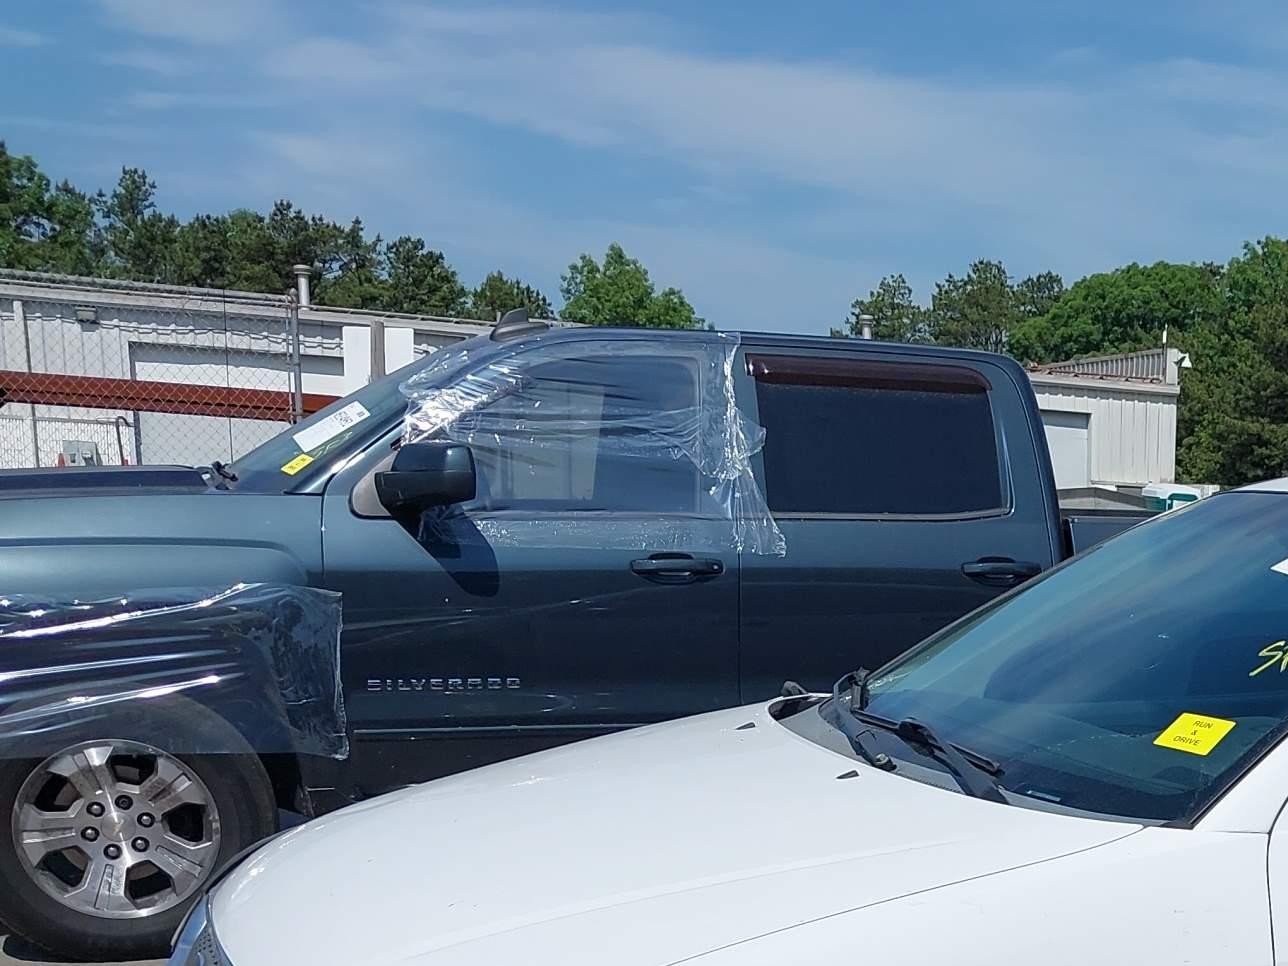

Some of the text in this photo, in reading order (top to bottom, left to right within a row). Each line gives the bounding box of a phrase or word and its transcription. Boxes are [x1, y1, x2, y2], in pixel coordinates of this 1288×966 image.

[367, 677, 521, 691] SILVERADO
[1192, 720, 1213, 729] RUN
[1173, 735, 1202, 746] DRIVE
